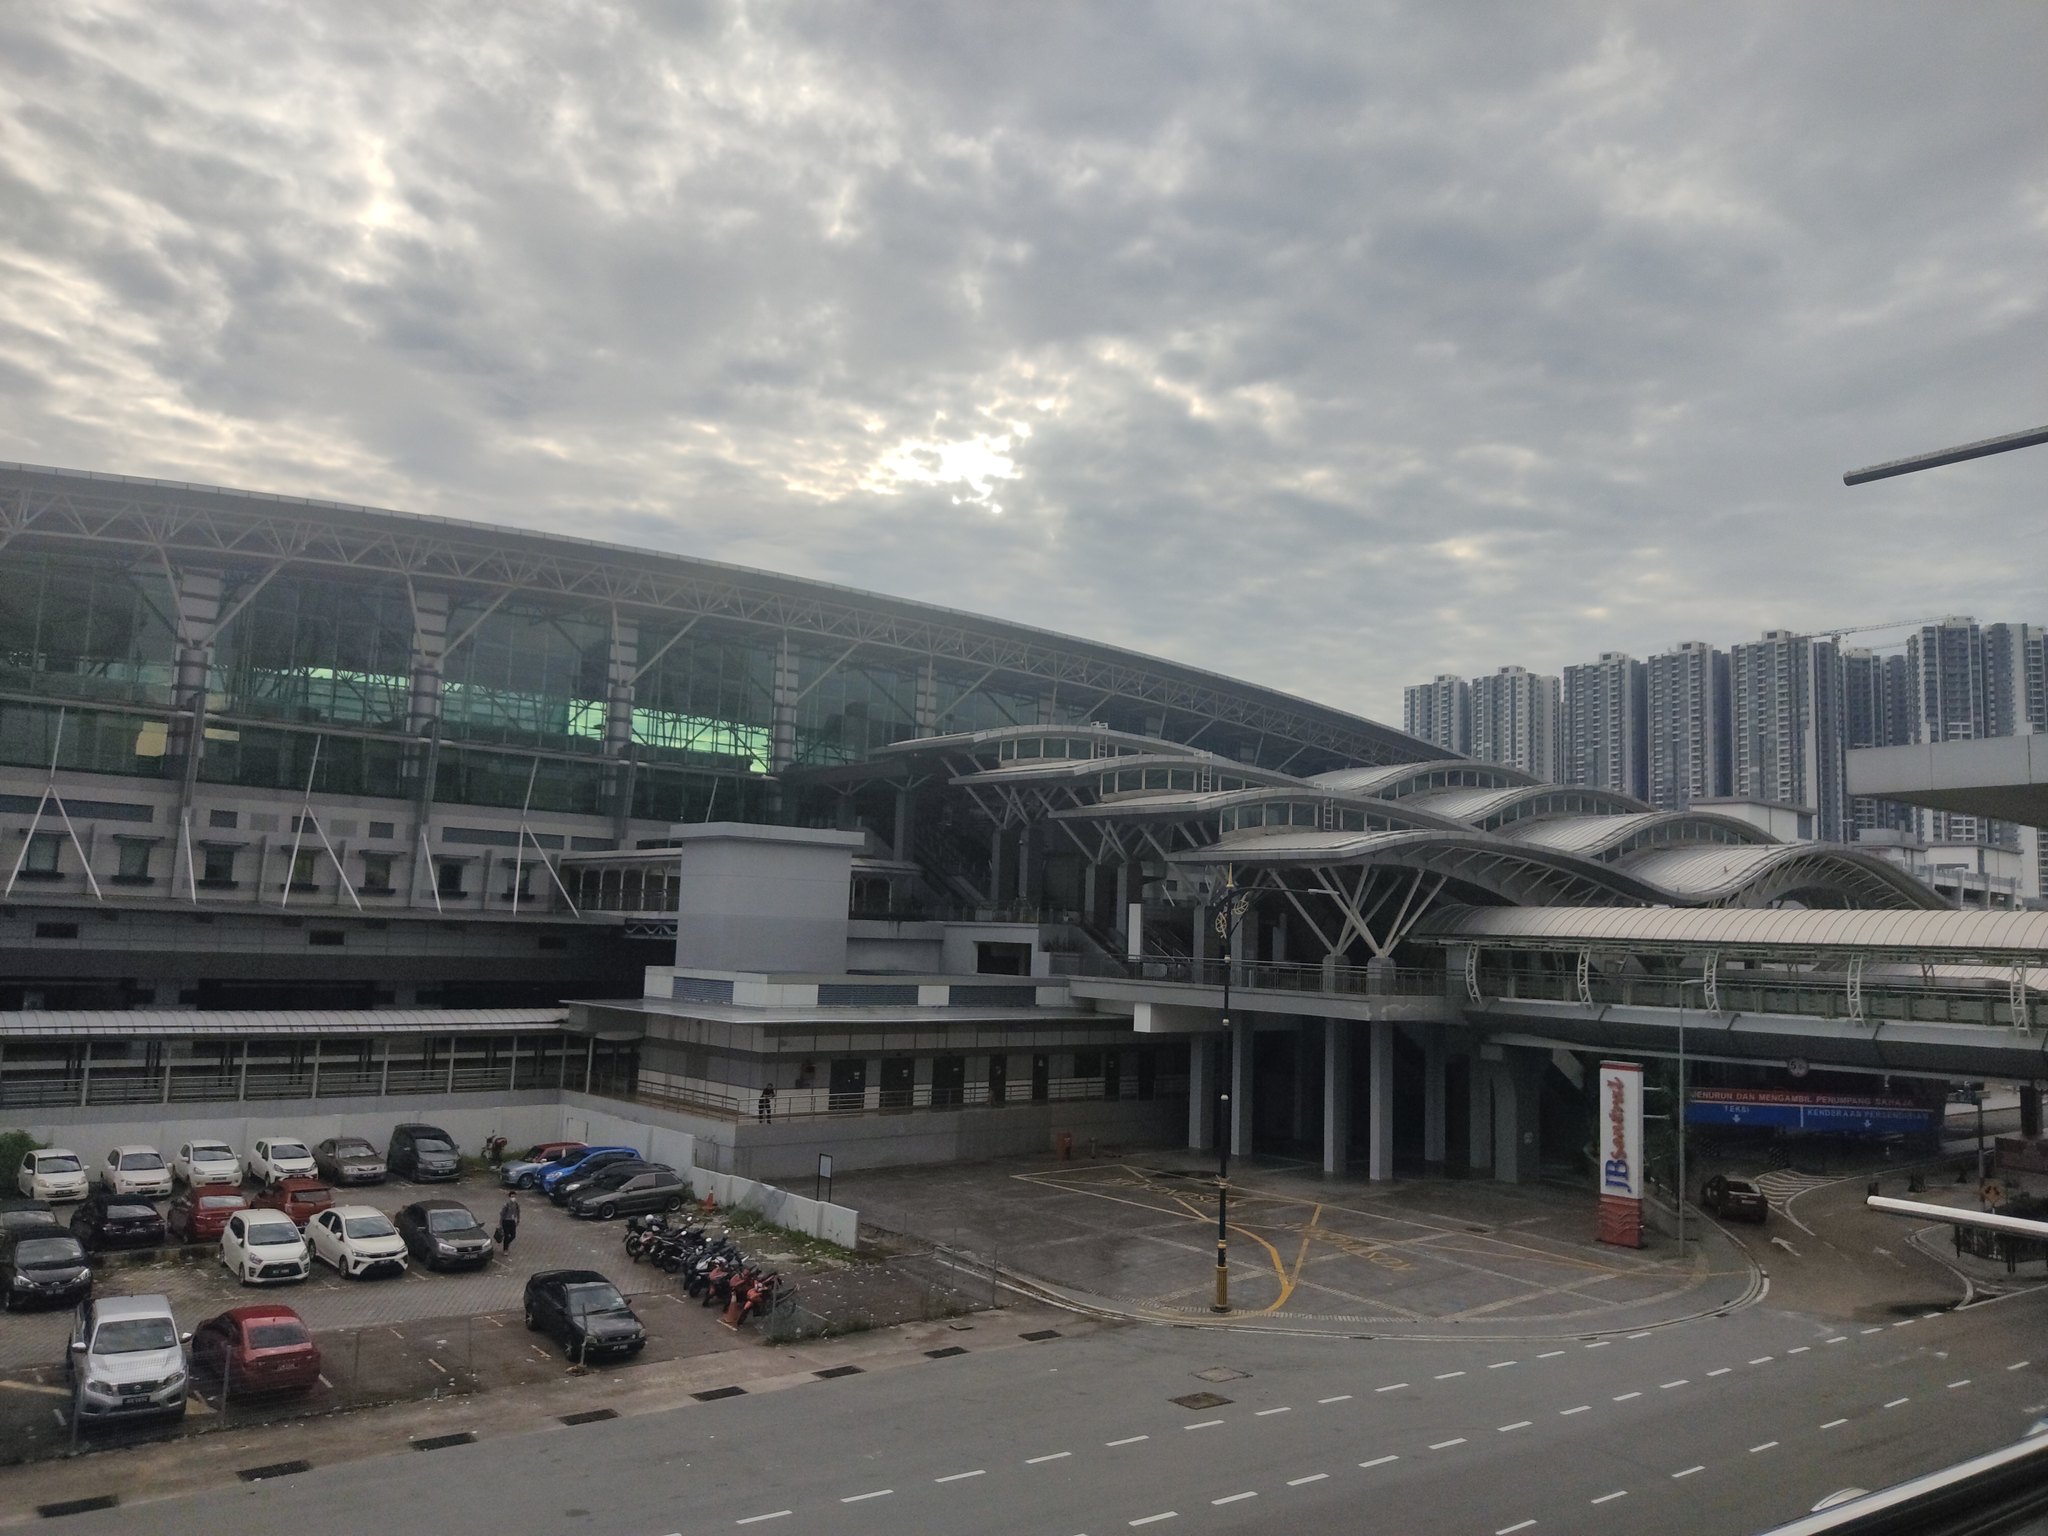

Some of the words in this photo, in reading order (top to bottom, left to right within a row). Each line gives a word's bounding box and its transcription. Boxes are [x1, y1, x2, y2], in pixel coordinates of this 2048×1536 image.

[1736, 1092, 1755, 1101] DAN
[1758, 1093, 1813, 1103] MENGAMBIL
[1816, 1095, 1871, 1105] PENUMPANG
[1725, 1105, 1750, 1113] TEKSI
[1808, 1109, 1861, 1118] KENDERAAN
